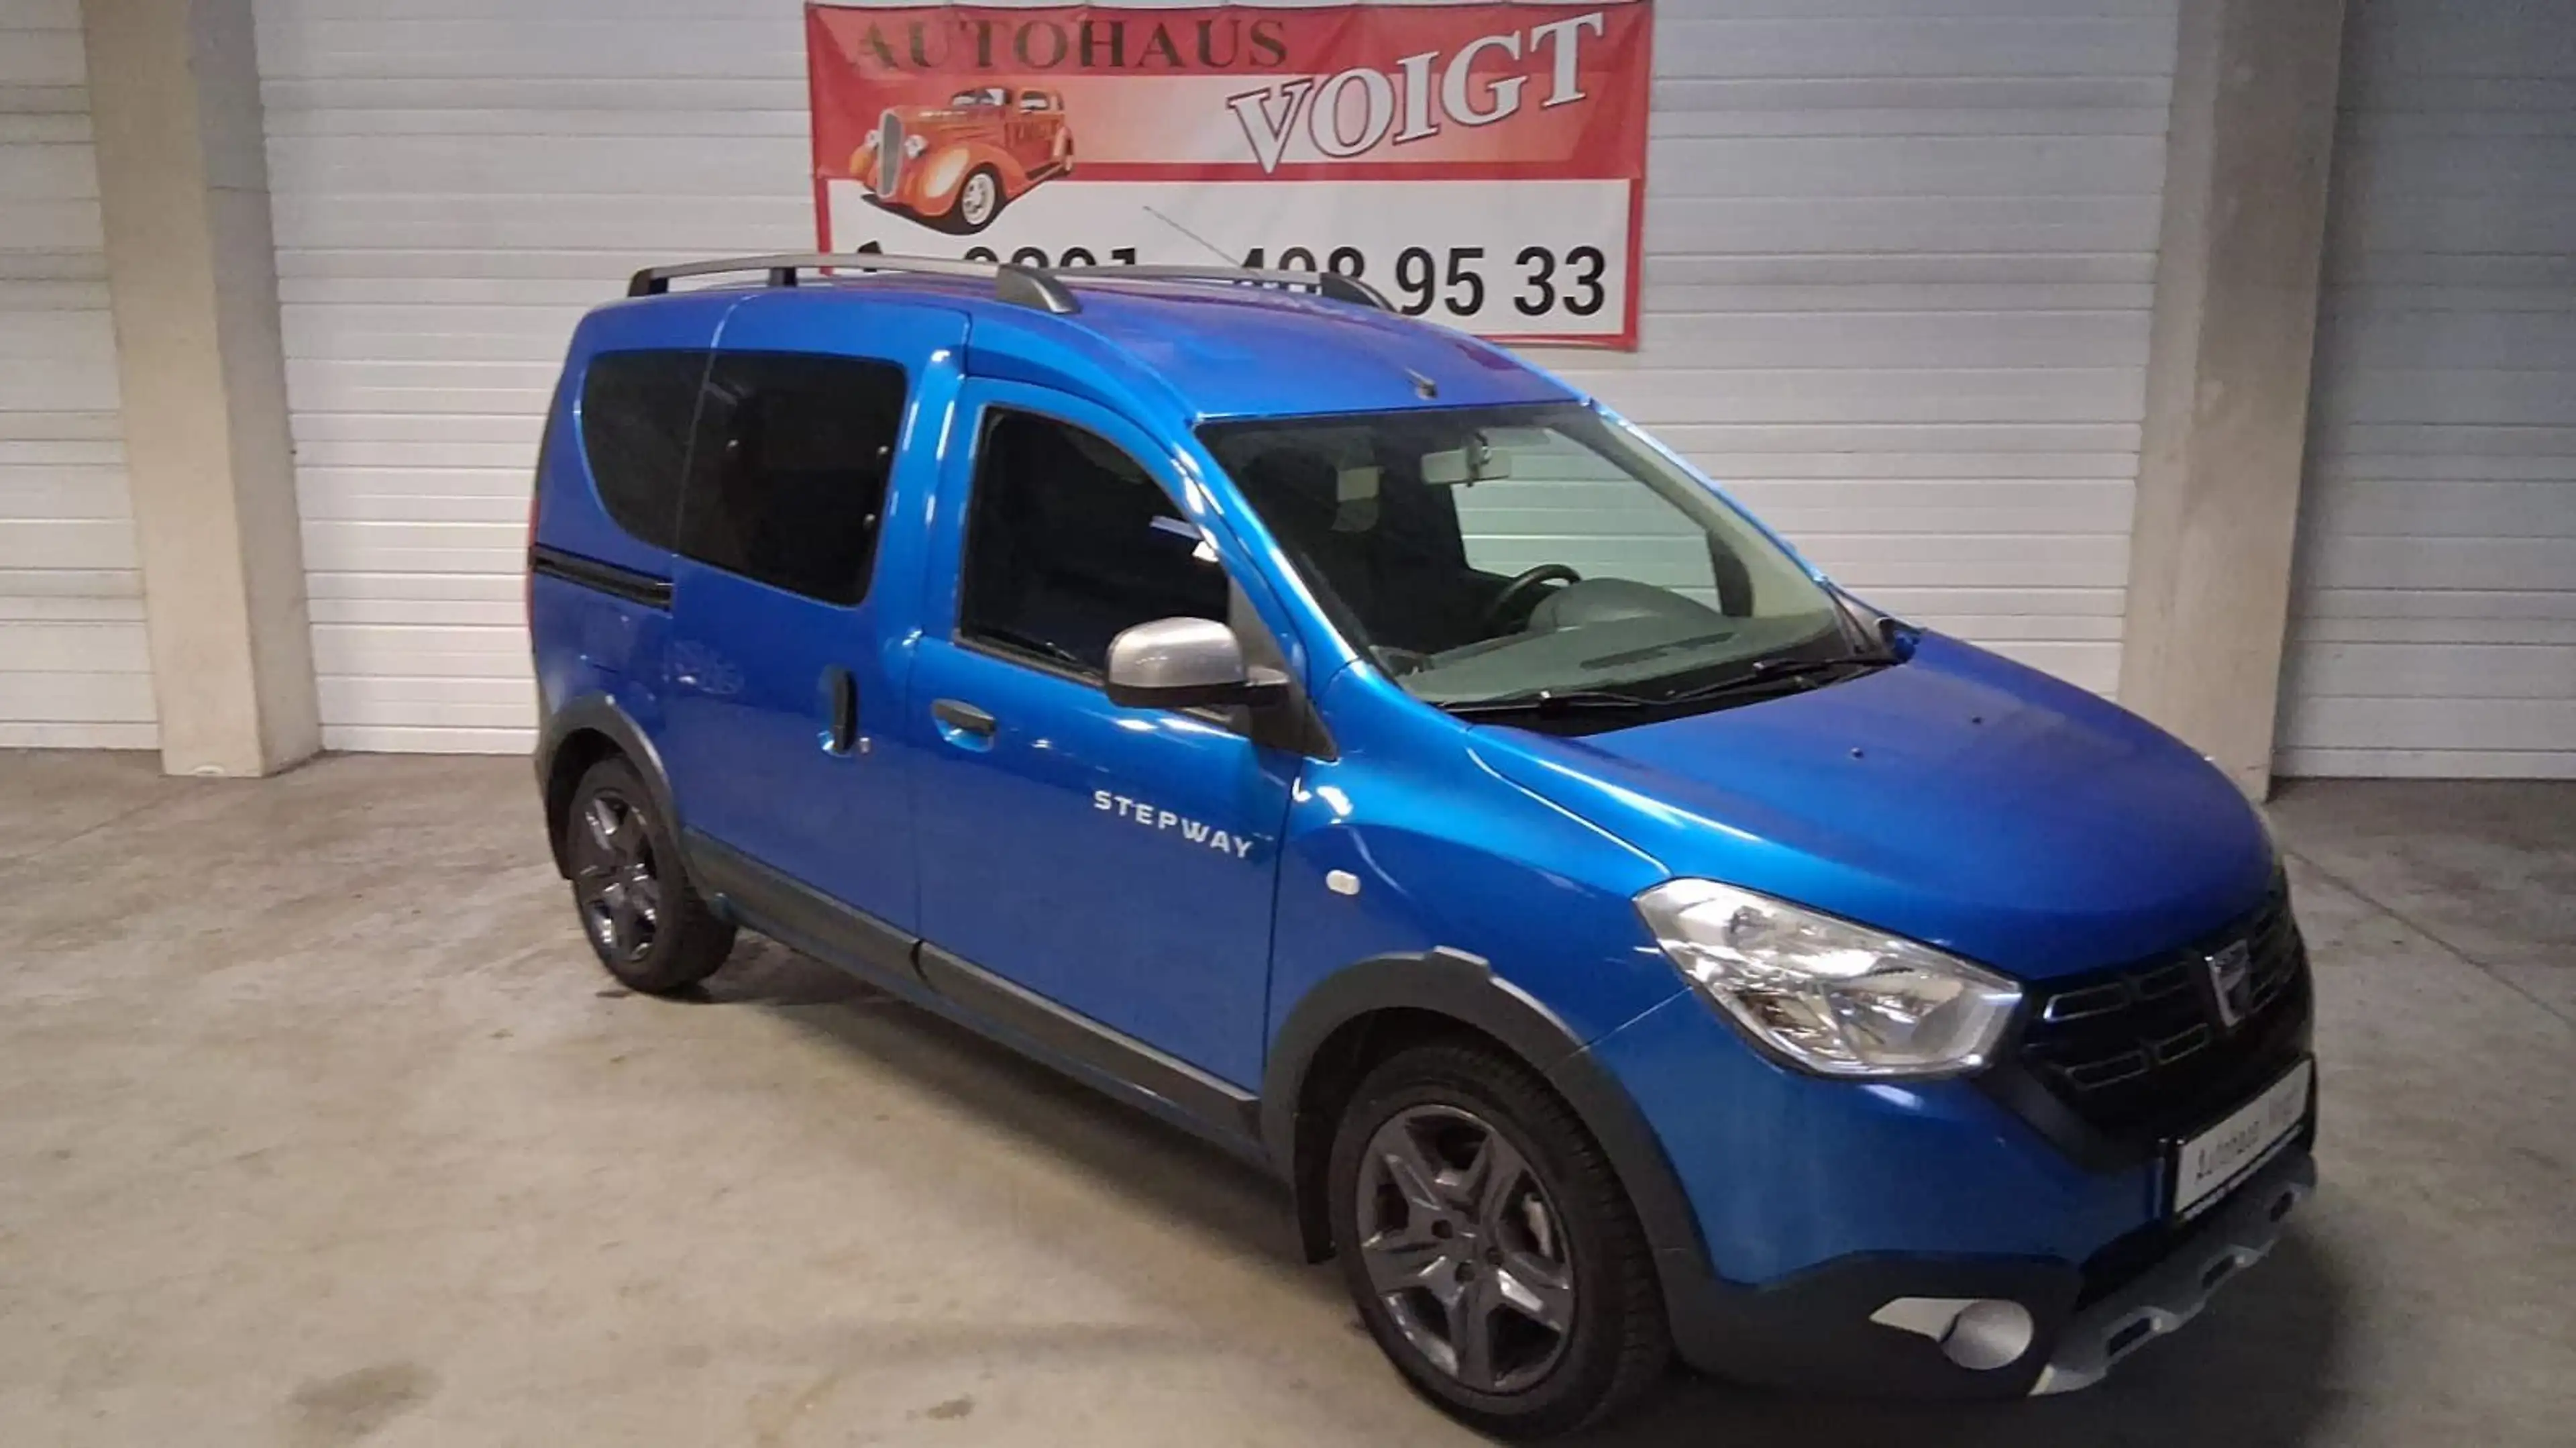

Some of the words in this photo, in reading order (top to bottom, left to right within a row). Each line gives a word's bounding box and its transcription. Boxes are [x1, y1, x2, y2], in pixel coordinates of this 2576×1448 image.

[857, 17, 1287, 69] AUTOHAUS
[1226, 12, 1604, 175] VOIGT
[1396, 246, 1485, 316] 95
[1513, 246, 1605, 316] 33
[1093, 790, 1254, 858] STEPWAY
